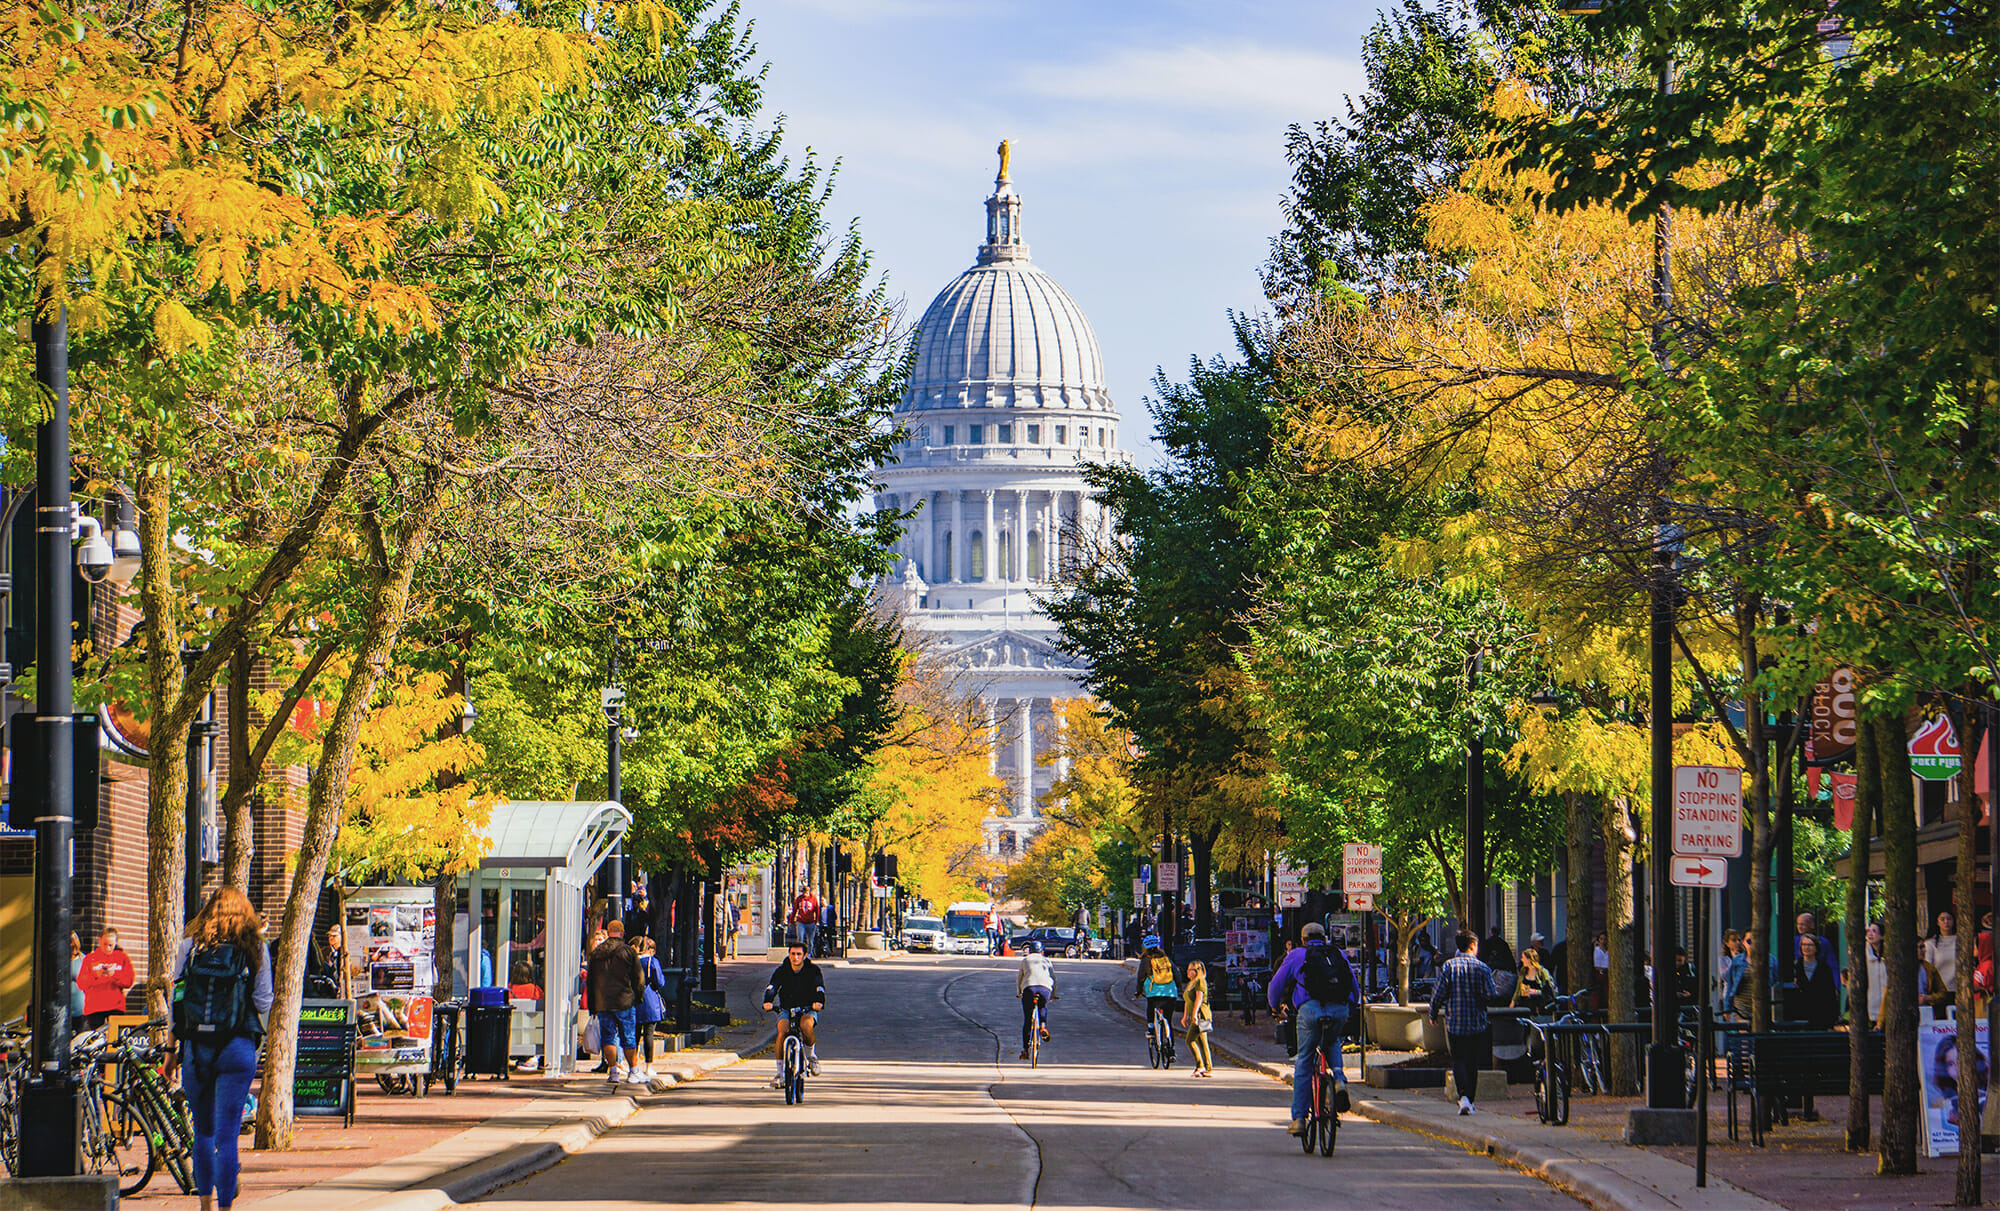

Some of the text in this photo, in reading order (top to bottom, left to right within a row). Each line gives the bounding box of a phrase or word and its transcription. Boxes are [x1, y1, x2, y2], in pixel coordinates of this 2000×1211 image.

[1814, 683, 1831, 742] BLOCK
[1911, 758, 1961, 769] POKE PLUS
[1697, 772, 1719, 788] NO
[1679, 792, 1737, 806] STOPPING
[1678, 808, 1737, 822] STANDING
[1681, 834, 1733, 848] PARKING
[1357, 847, 1369, 856] NO
[1346, 858, 1379, 866] STOPPING
[1346, 867, 1379, 875] STANDING
[1348, 881, 1377, 889] PARKING
